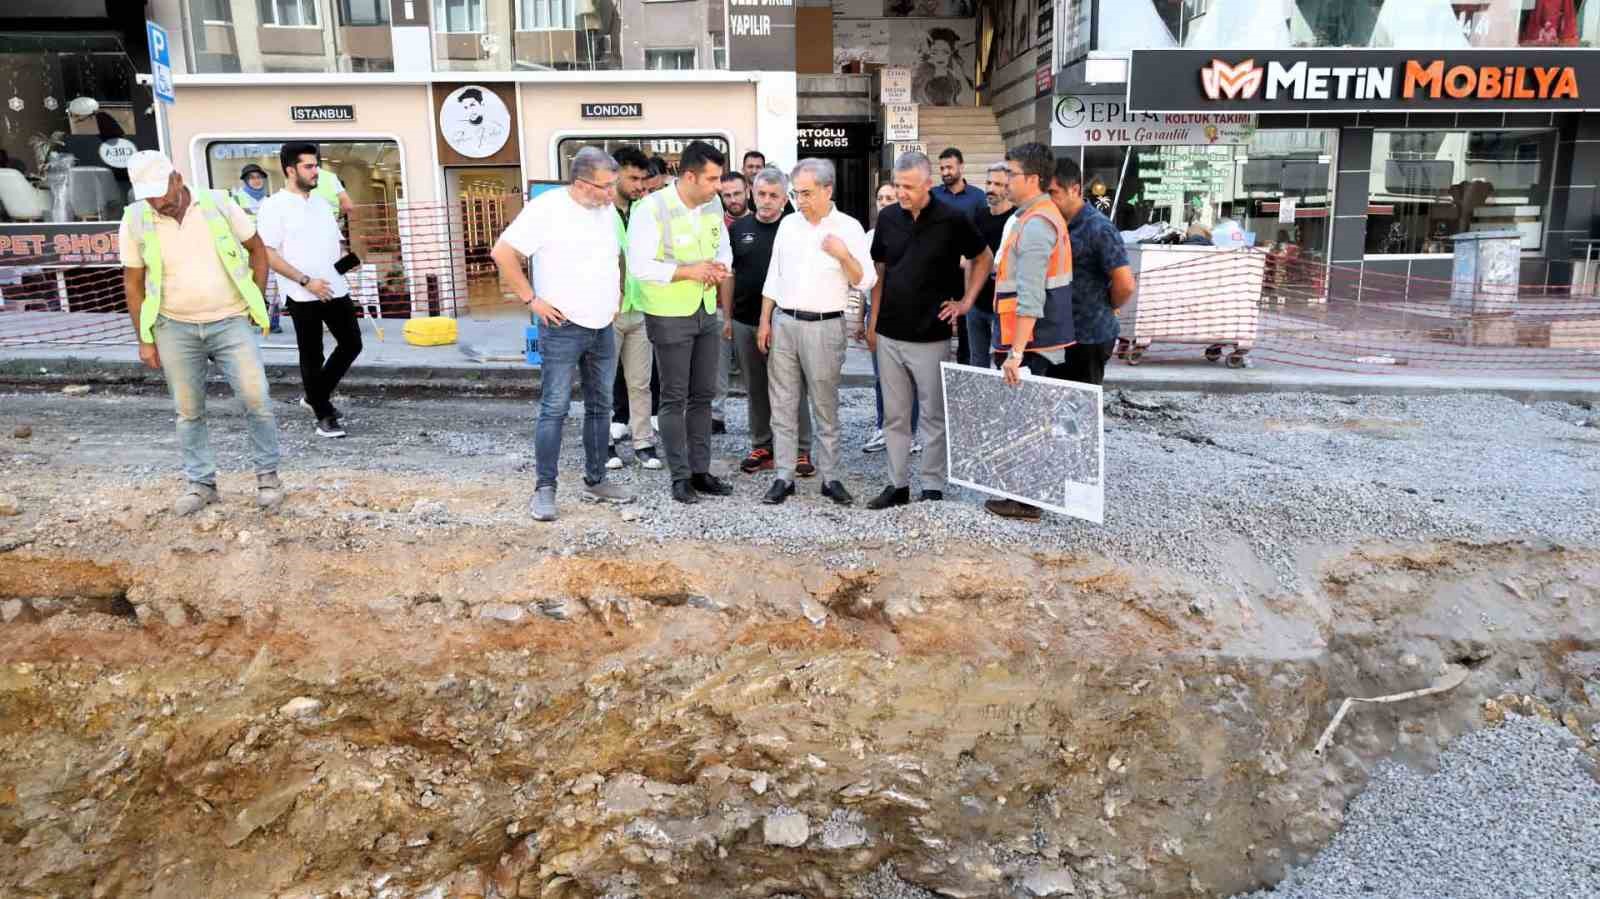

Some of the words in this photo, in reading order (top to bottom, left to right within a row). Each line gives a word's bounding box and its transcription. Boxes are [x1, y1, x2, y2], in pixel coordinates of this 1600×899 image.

[730, 15, 770, 35] YAPILIR
[152, 28, 164, 59] P
[294, 106, 351, 119] İSTANBUL
[586, 104, 638, 116] LONDON
[1165, 113, 1210, 124] KOLTUK
[1214, 113, 1251, 123] TAKIMI
[797, 127, 846, 138] RTOĞLU
[1085, 129, 1101, 141] 10
[1107, 129, 1130, 141] YIL
[814, 137, 848, 147] NO:65
[0, 234, 45, 256] PET
